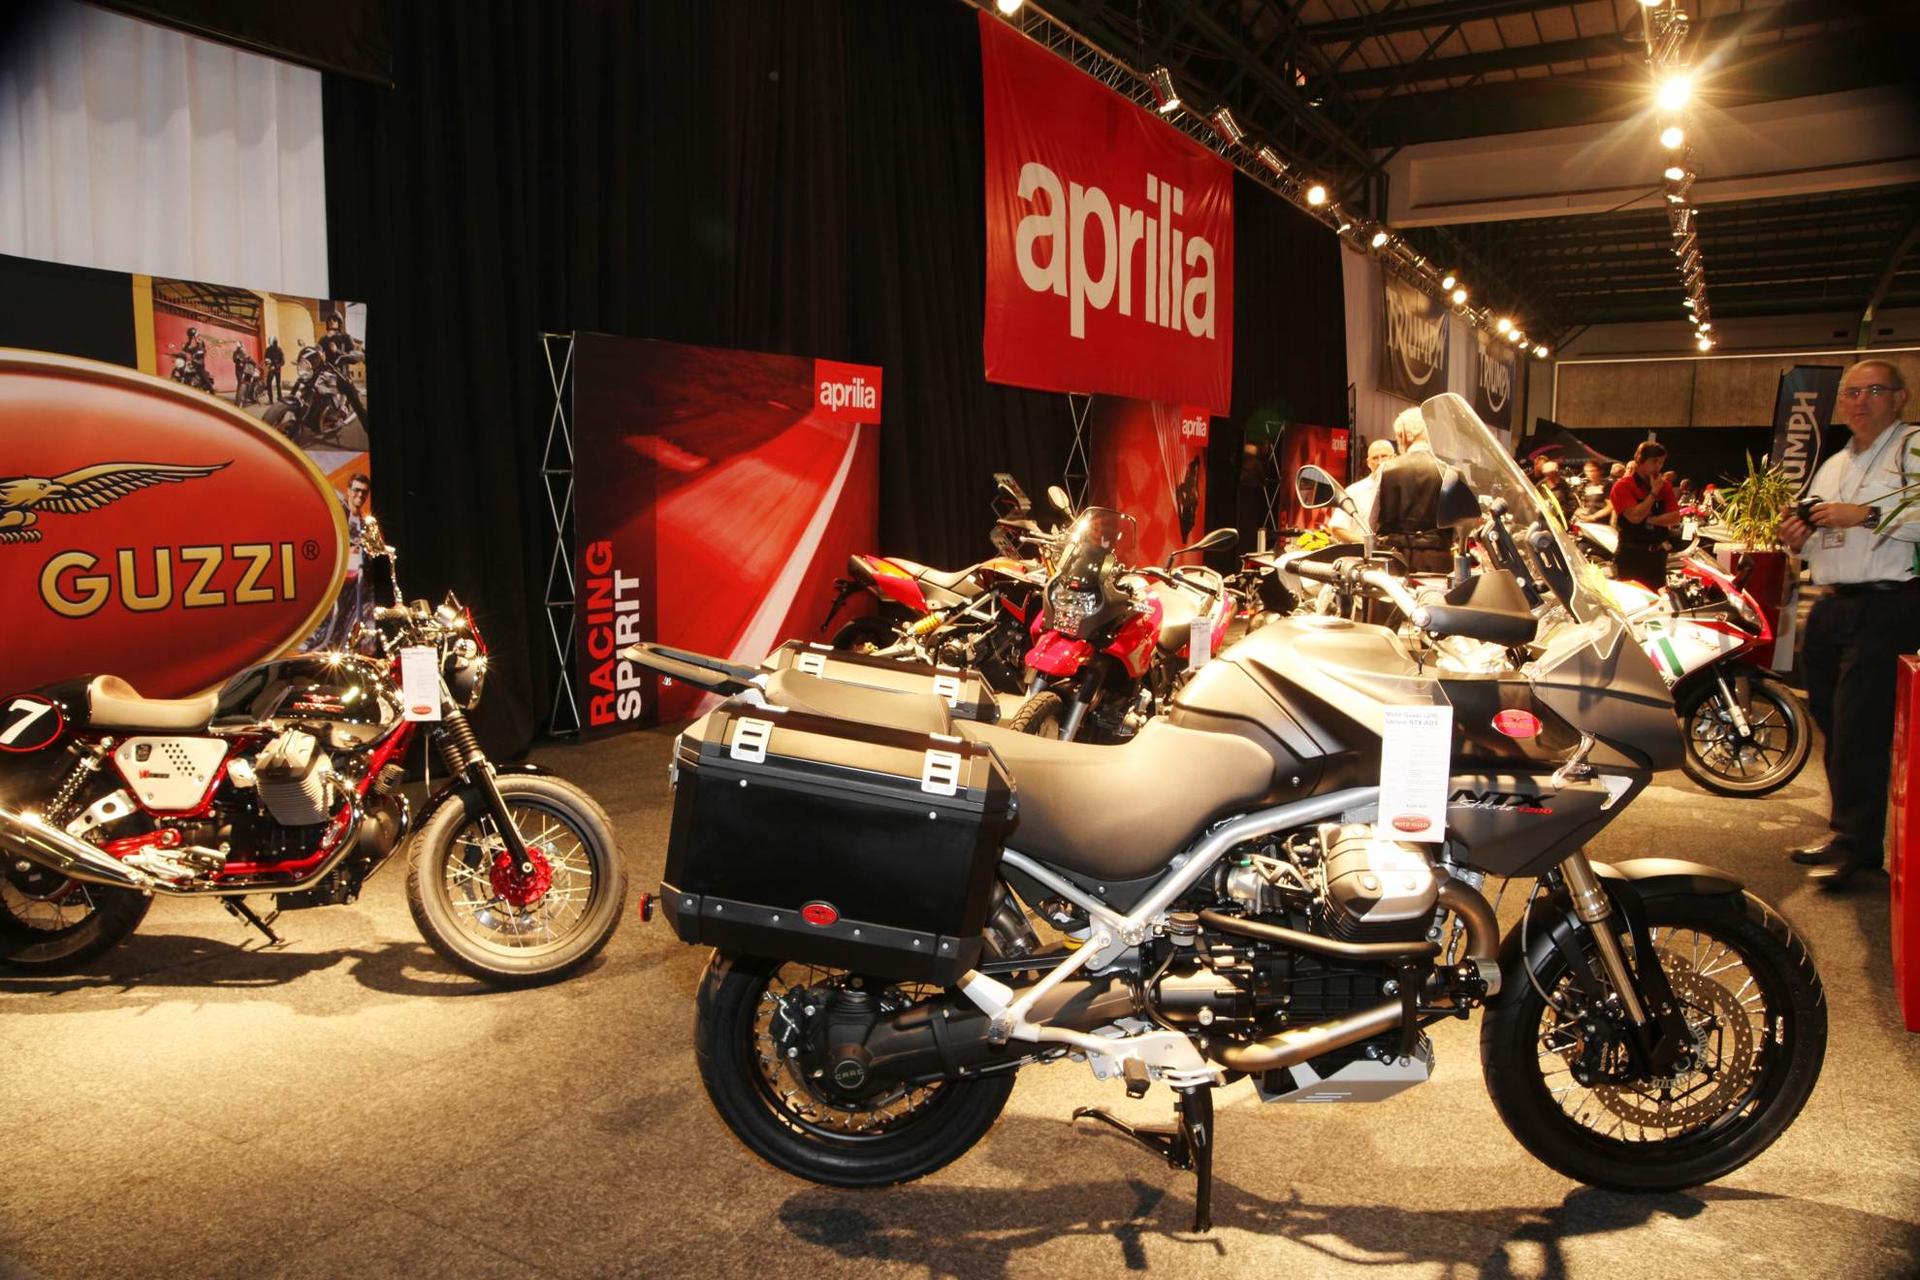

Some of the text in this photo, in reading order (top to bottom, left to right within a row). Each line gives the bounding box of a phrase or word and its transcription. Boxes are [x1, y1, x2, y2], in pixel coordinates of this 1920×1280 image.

[1015, 162, 1215, 339] aprilia
[820, 377, 876, 412] aprilia
[1182, 416, 1206, 438] aprilia
[1781, 391, 1821, 498] IUMPH
[585, 541, 616, 726] RACING
[0, 699, 53, 745] 7
[1449, 789, 1555, 807] NTX
